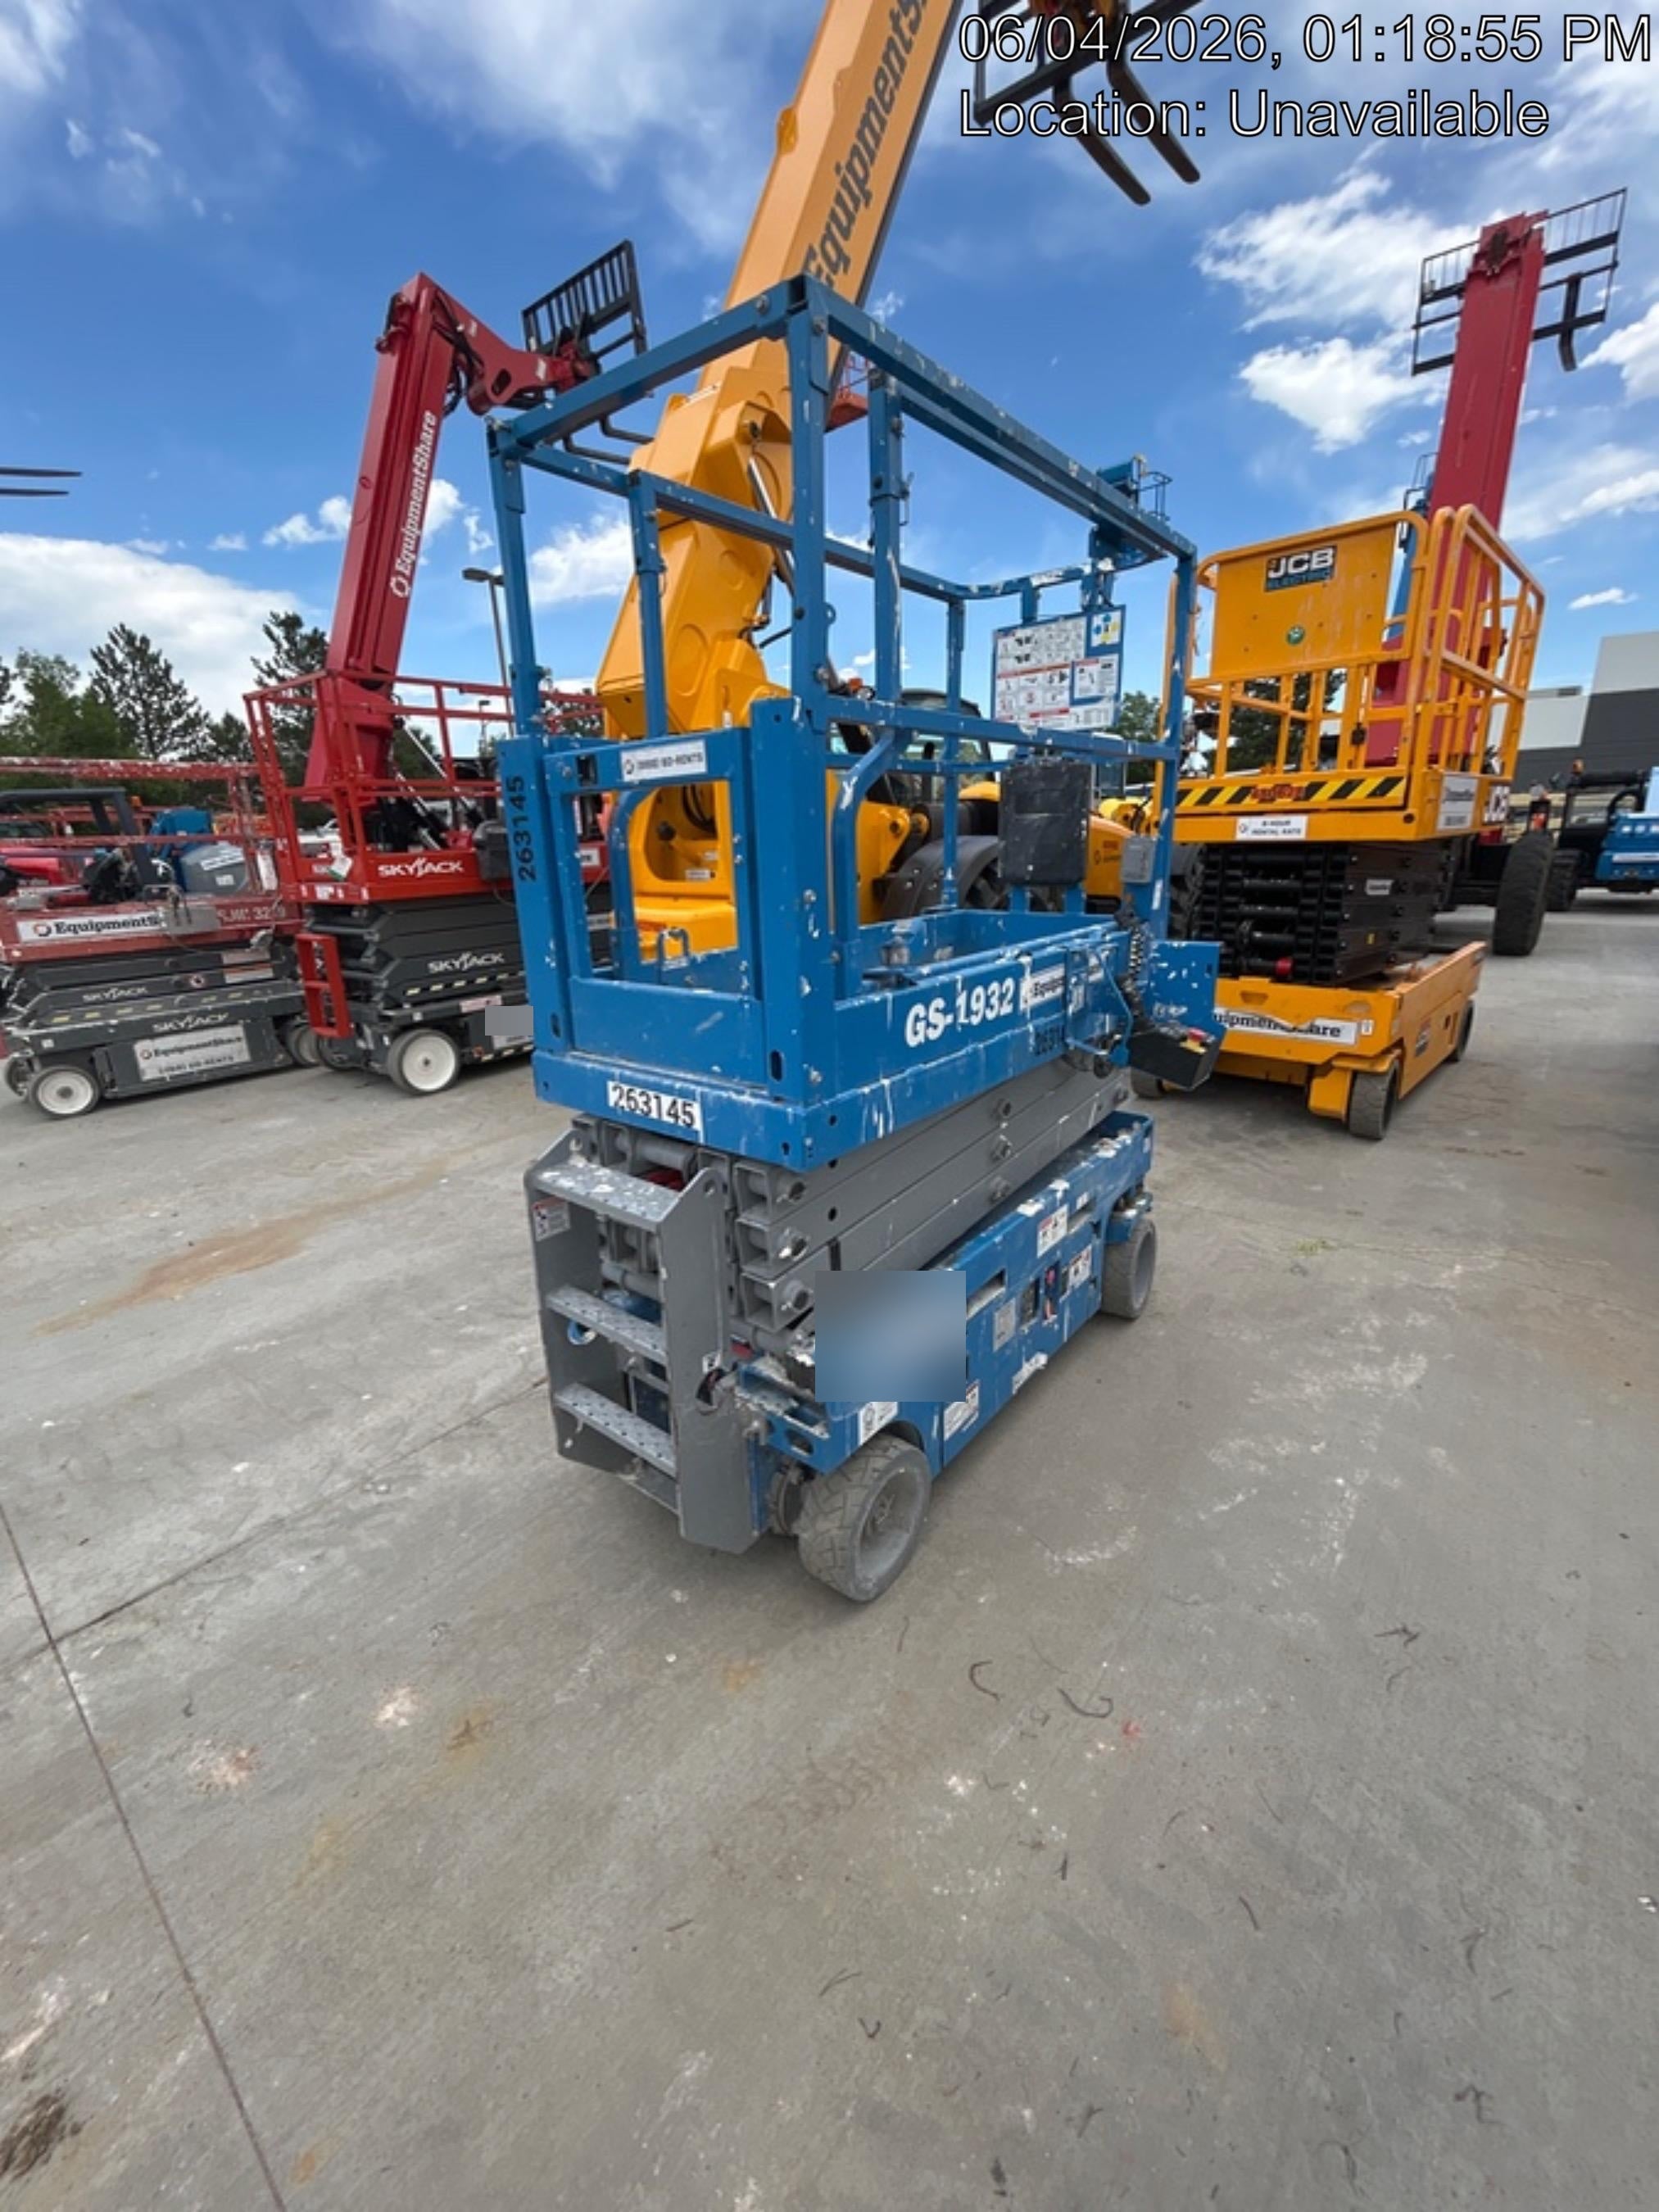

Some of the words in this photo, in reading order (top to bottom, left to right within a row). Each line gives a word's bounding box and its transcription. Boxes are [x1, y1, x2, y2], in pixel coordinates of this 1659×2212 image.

[803, 0, 927, 287] EquipmentS
[1267, 548, 1334, 578] JCB
[505, 775, 537, 882] 263145
[377, 857, 465, 877] SKYJACK
[427, 951, 505, 974] SKYJACK
[83, 987, 148, 1003] SKYJACK
[152, 1012, 229, 1032] SKYJACK
[905, 977, 1016, 1048] GS-1932
[611, 1084, 696, 1128] 263145
